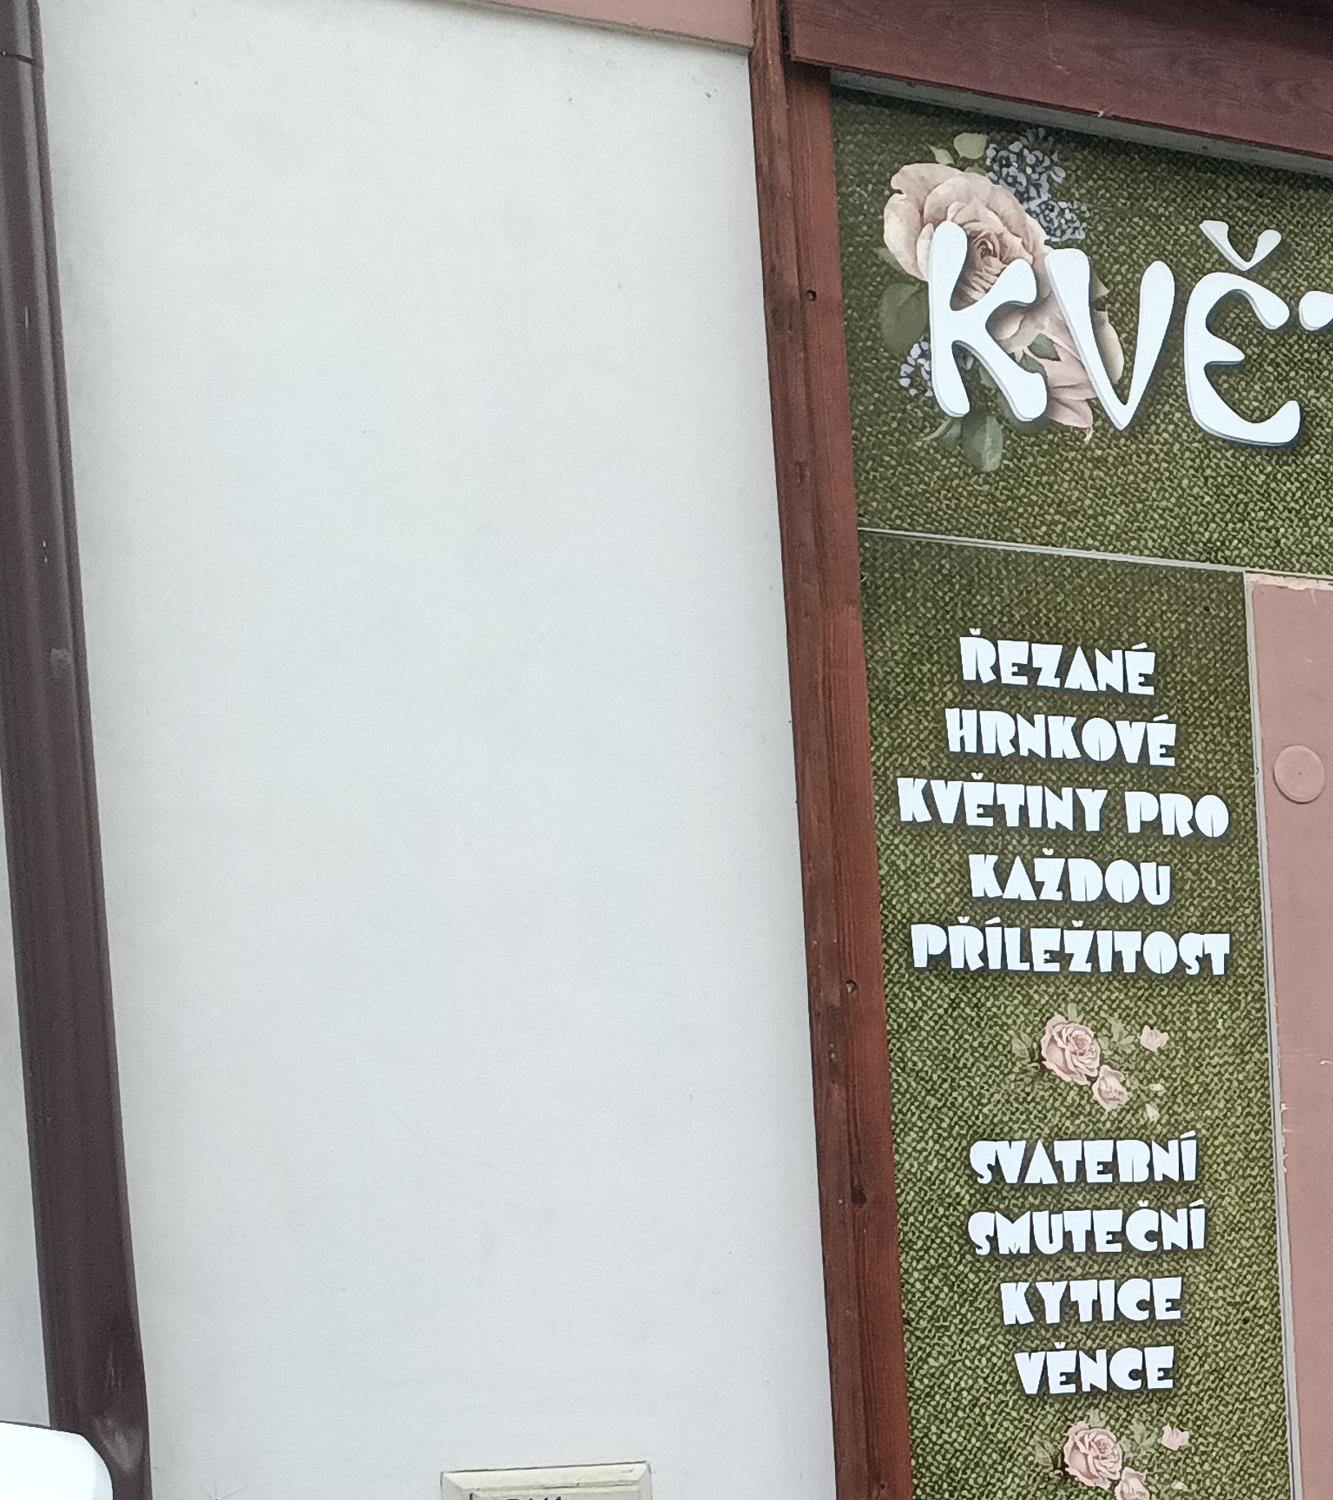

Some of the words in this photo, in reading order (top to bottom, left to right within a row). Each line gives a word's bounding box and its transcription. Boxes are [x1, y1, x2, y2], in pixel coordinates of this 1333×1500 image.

[959, 628, 1156, 697] ŘEZANÉ
[944, 707, 1177, 767] HRNKOVÉ
[897, 772, 1109, 832] KVĚTINY
[1124, 790, 1230, 839] PRO
[968, 848, 1171, 906] KAŽDOU
[910, 915, 1231, 976] PŘÍLEŽITOST
[969, 1130, 1198, 1184] SVATEBNÍ
[967, 1199, 1206, 1256] SMUTEČNÍ
[1000, 1276, 1183, 1325] KYTICE
[1014, 1341, 1175, 1395] VĚNCE
